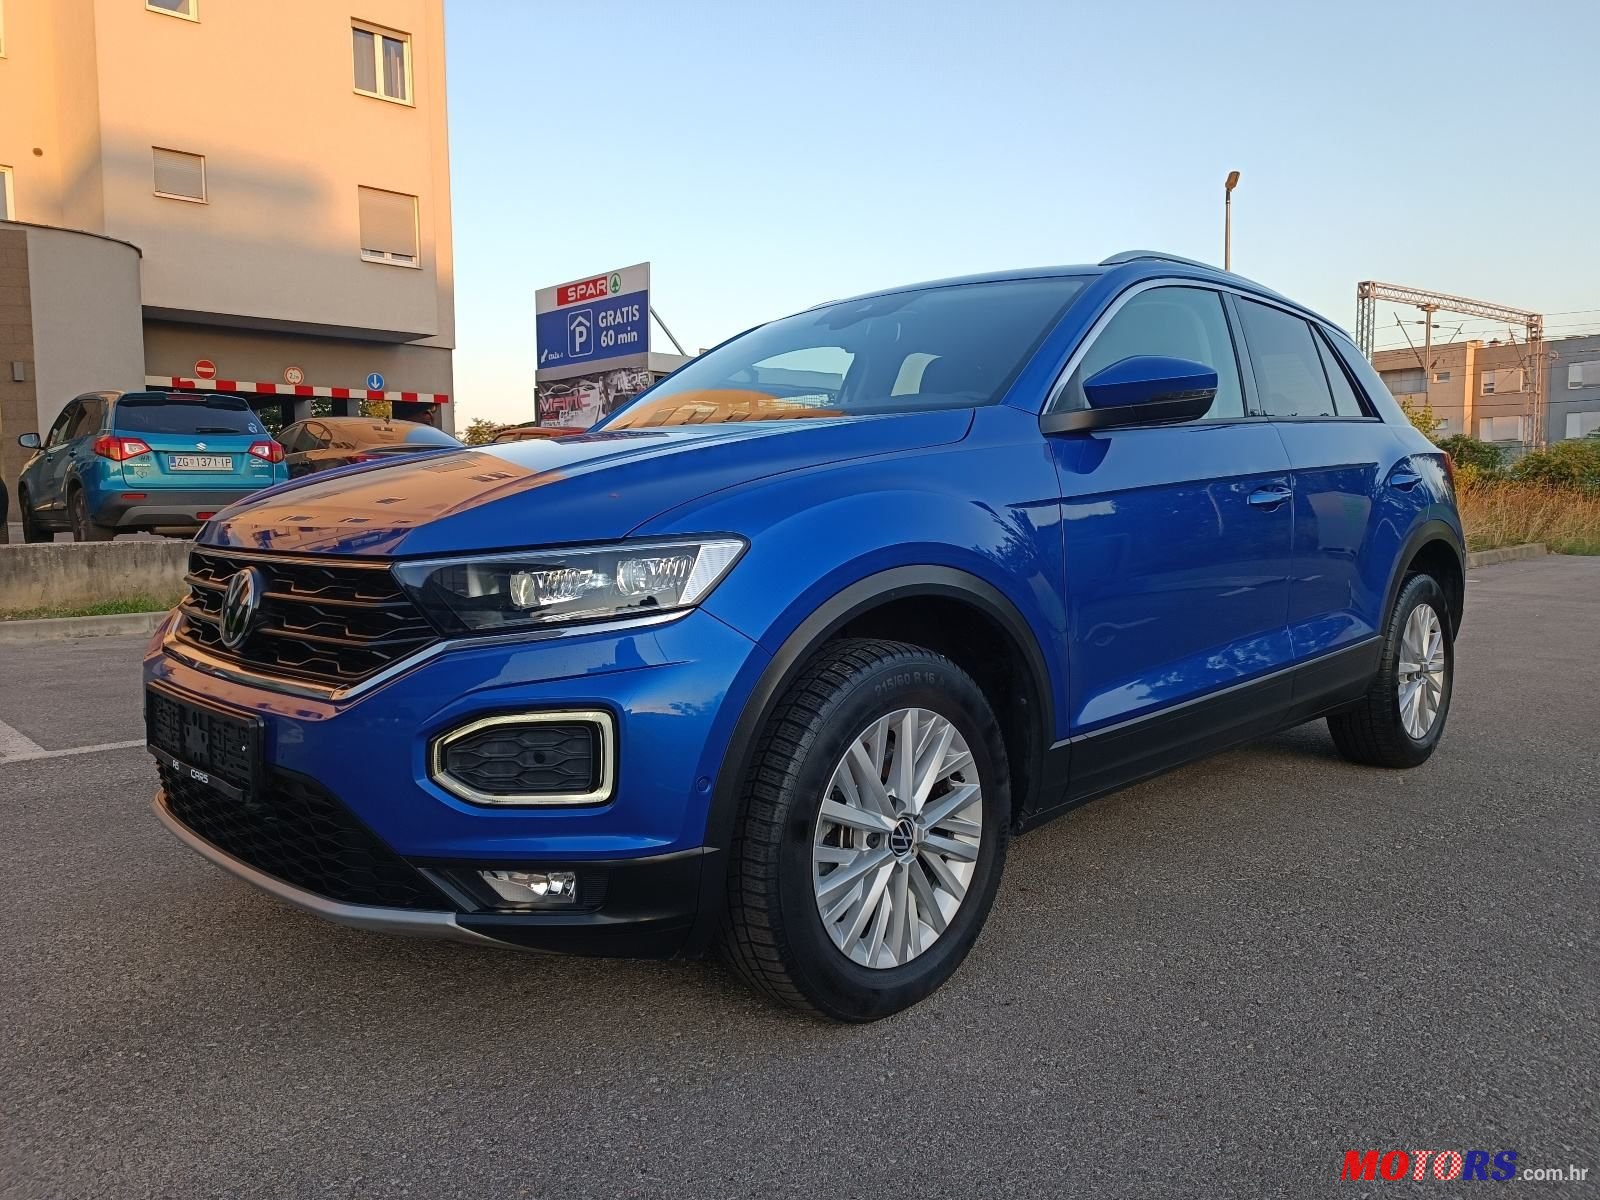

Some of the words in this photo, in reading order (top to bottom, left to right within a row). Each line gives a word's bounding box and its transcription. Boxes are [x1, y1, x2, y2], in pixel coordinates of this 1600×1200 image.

[567, 279, 607, 302] SPAR
[598, 304, 640, 328] GRATIS
[600, 329, 615, 348] 60
[617, 326, 638, 345] min
[176, 457, 189, 467] ZG
[190, 768, 209, 784] CARS
